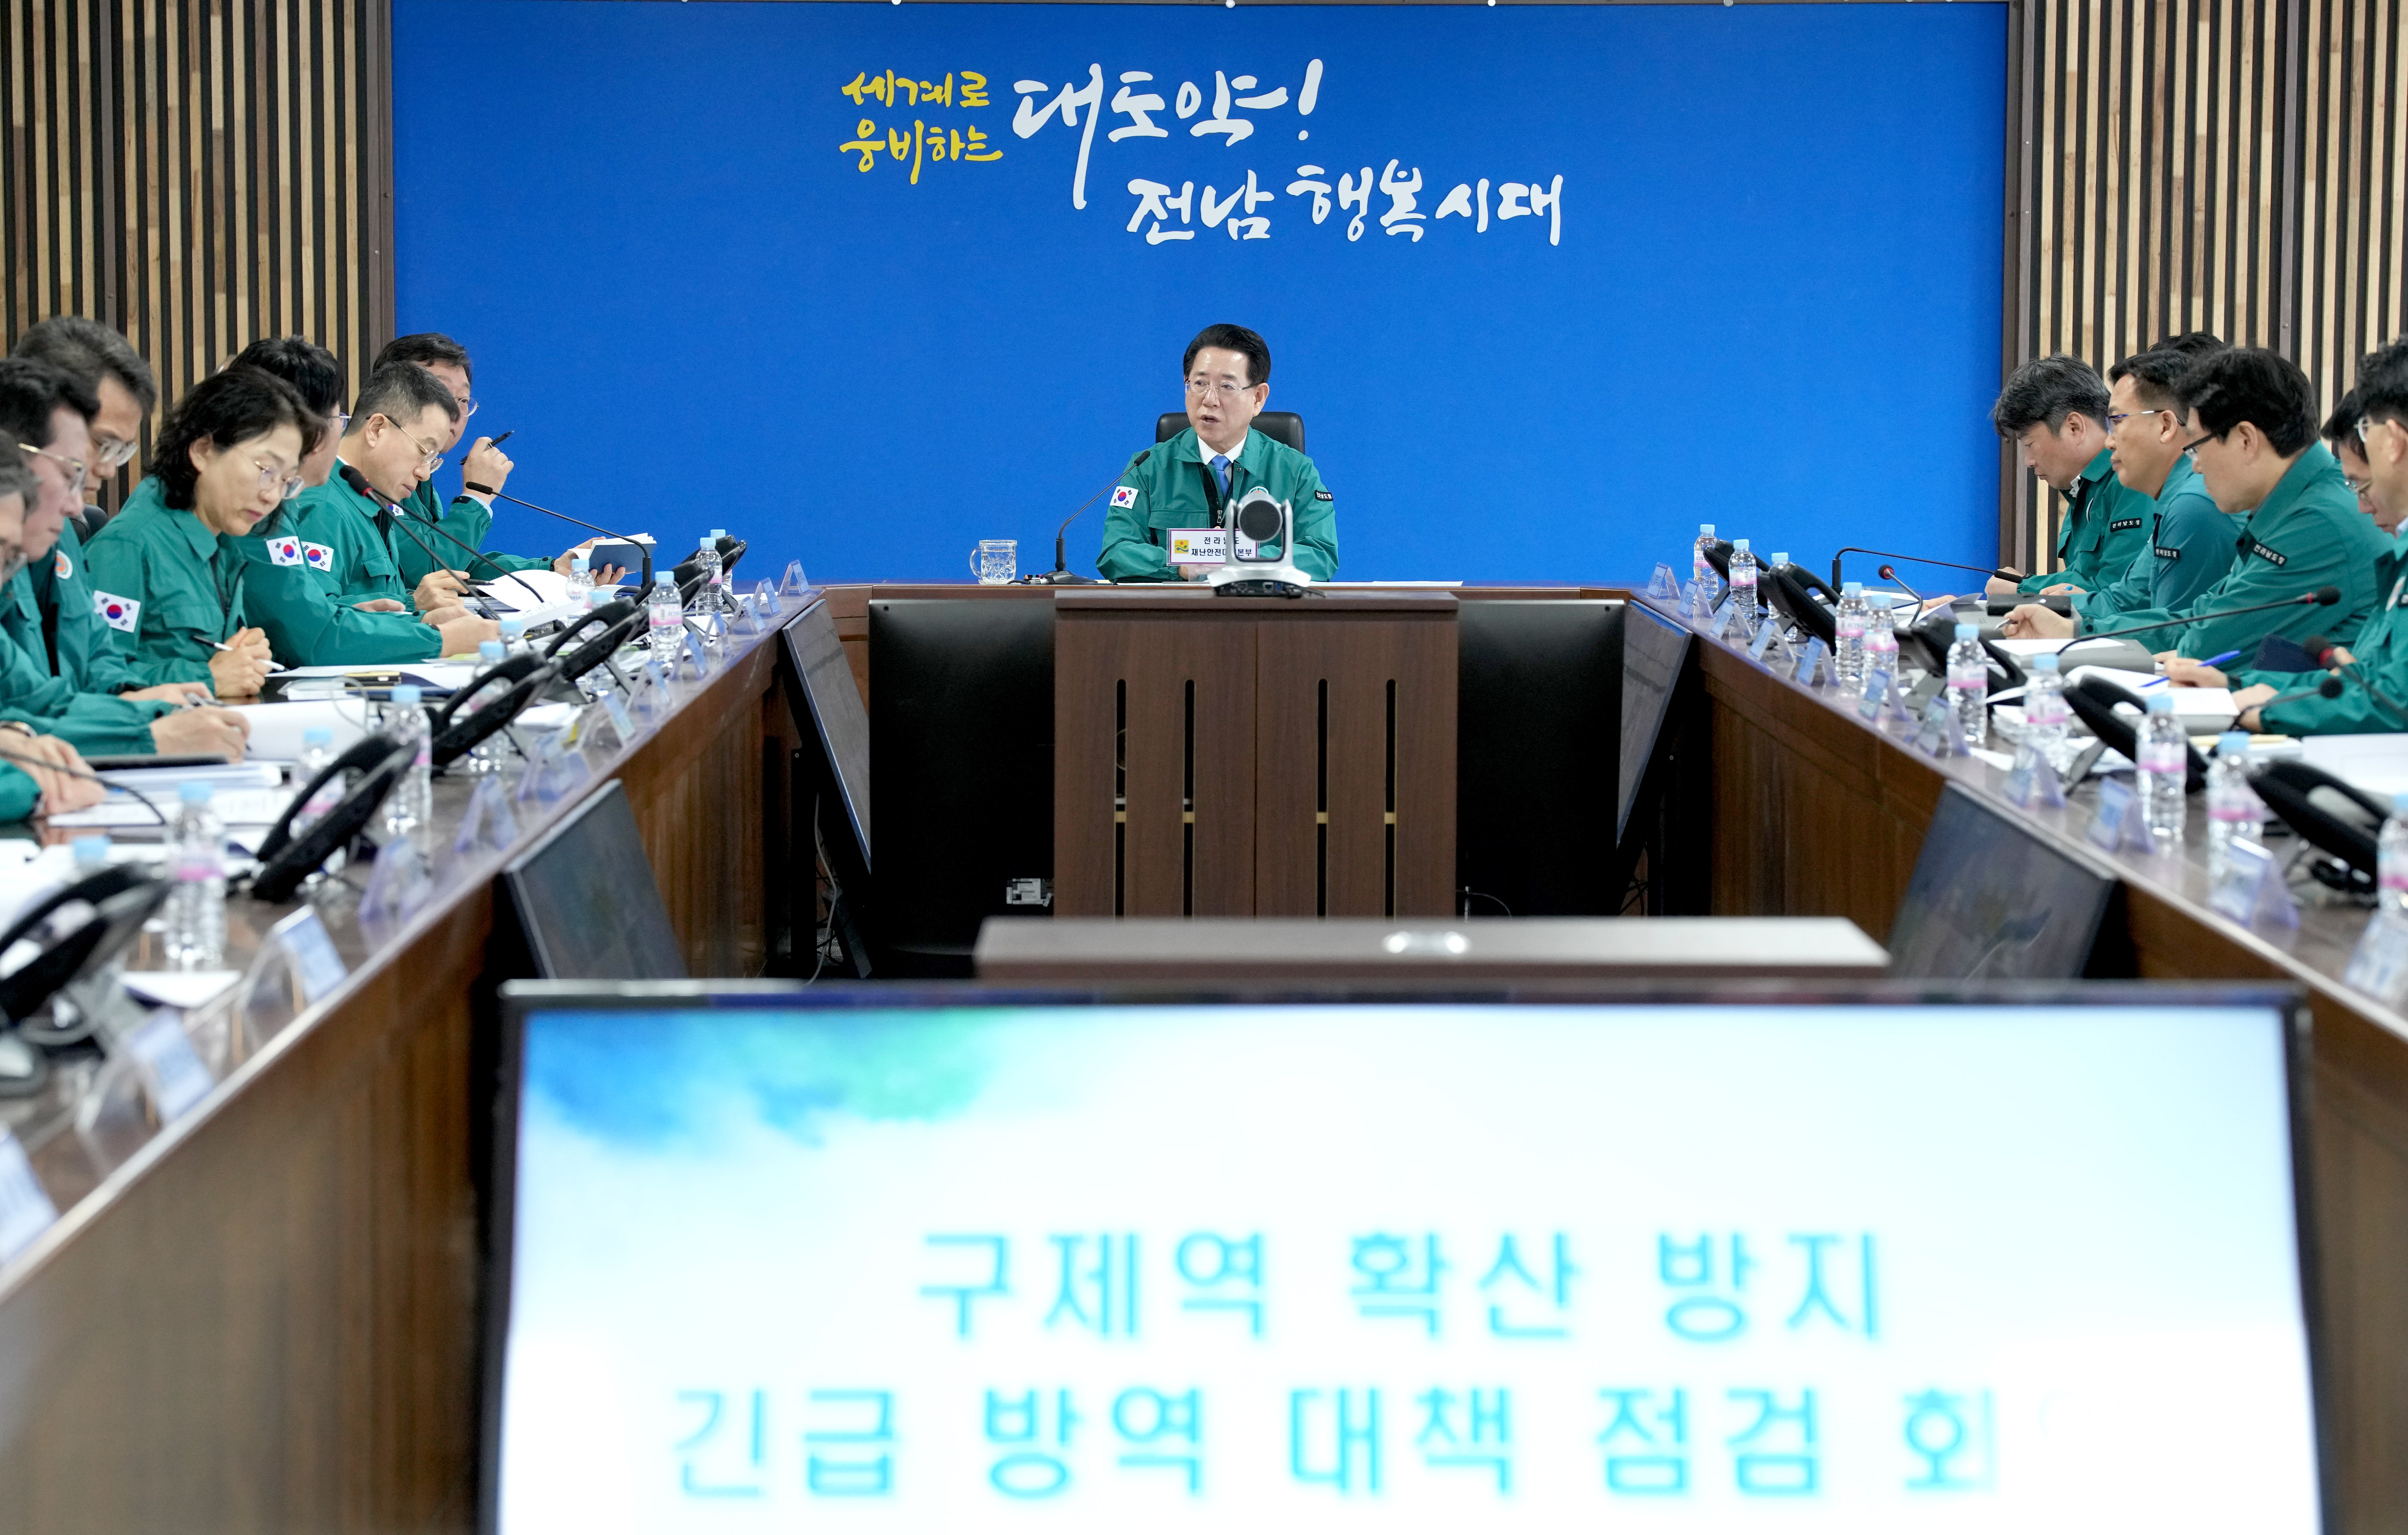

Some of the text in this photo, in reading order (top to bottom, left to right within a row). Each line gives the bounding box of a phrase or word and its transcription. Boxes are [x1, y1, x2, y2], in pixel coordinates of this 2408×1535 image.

[840, 69, 990, 108] 세계로
[839, 119, 1003, 185] 웅비하는
[1012, 58, 1324, 210] 대도약!
[1126, 169, 1275, 246] 전남
[2112, 520, 2140, 529] 전라남도청
[916, 1228, 1884, 1346] 구제역 확산 방지
[672, 1385, 904, 1501] 긴급
[980, 1383, 1207, 1503] 방역
[1286, 1383, 1516, 1499] 대책
[1593, 1383, 1824, 1501] 점검
